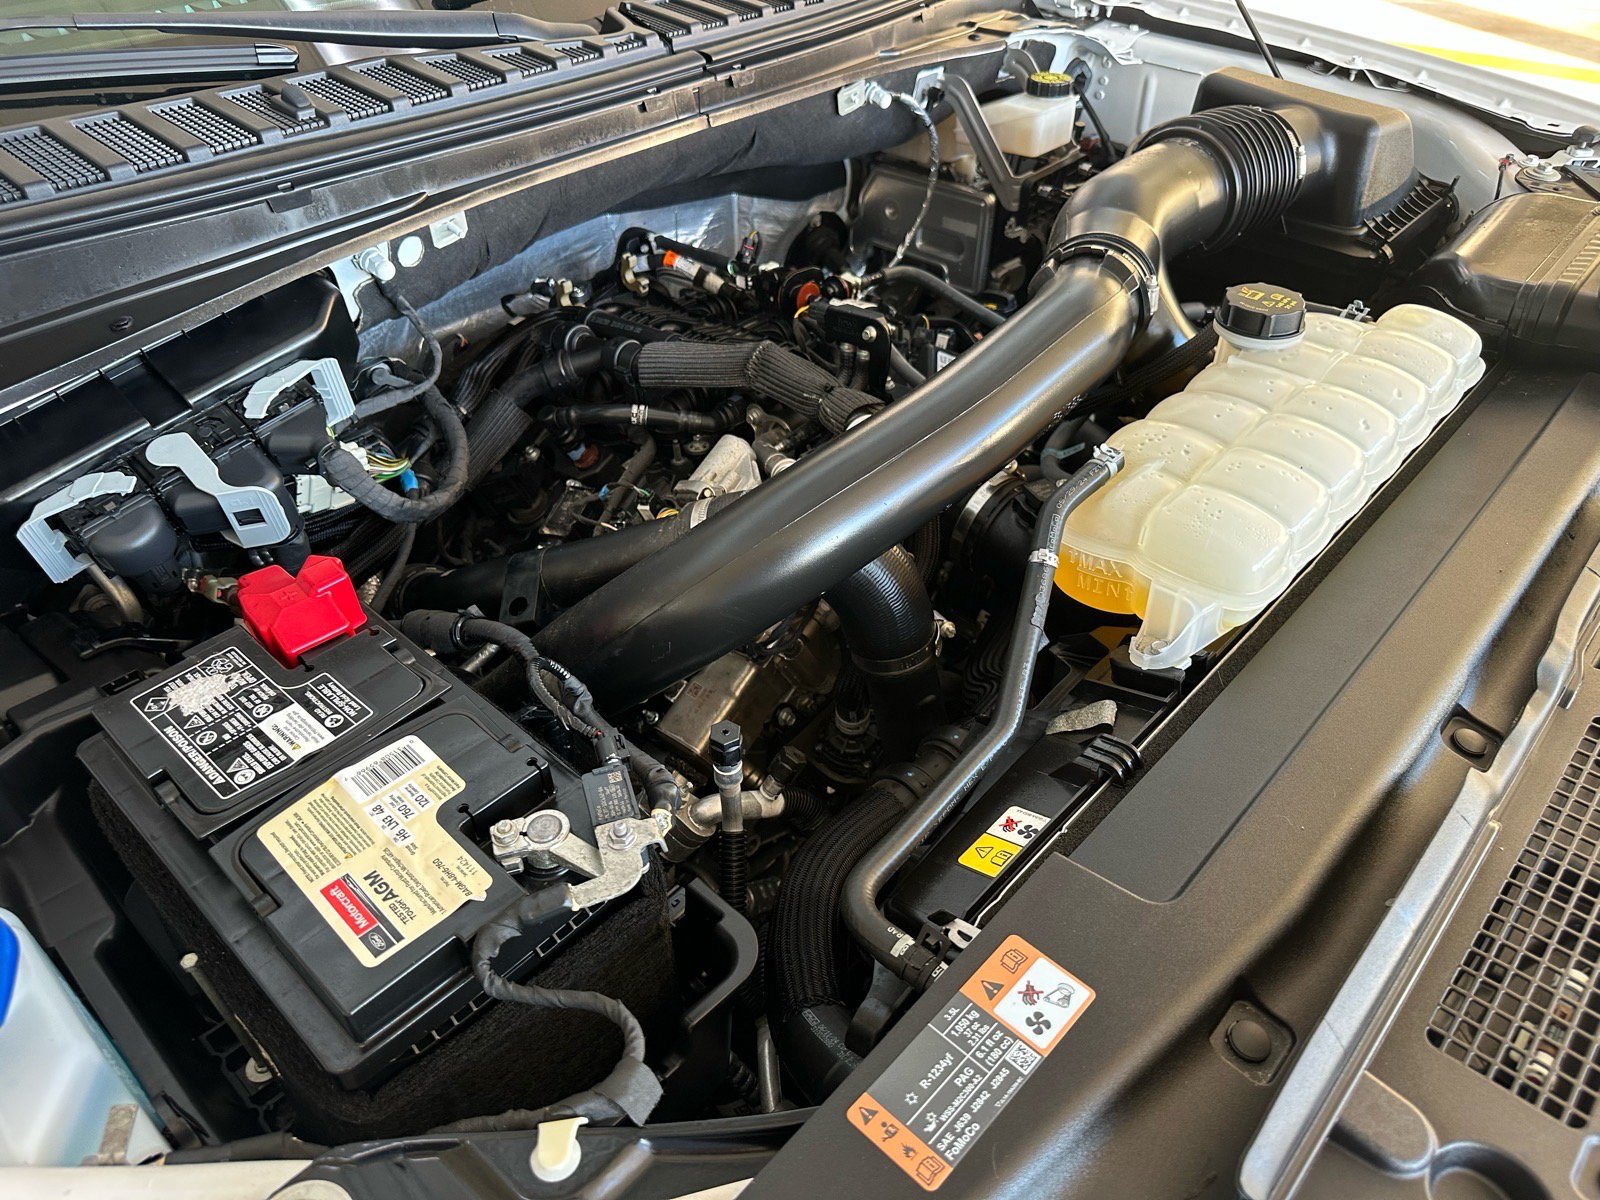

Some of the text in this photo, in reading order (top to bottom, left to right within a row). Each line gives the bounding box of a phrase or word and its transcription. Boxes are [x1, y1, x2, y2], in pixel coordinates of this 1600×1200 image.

[1079, 551, 1123, 578] MAX
[1077, 574, 1121, 598] MIN
[315, 683, 357, 716] NON-SPILLABLE
[270, 723, 296, 746] WARNING:
[163, 725, 220, 780] DANGER/POISON
[397, 803, 414, 819] 760
[413, 793, 430, 807] 120
[371, 803, 411, 841] H6 LN3 48
[456, 855, 478, 875] 111424
[362, 868, 399, 905] AGM
[327, 884, 370, 929] Motorcraft
[387, 901, 410, 925] TESTED
[943, 1004, 960, 1021] 3.5L
[949, 1007, 980, 1038] 1.050 kg
[962, 1020, 981, 1038] 37 oz
[966, 1022, 990, 1047] 2.31 lbs
[974, 1029, 1004, 1059] 6.1 fl oz
[984, 1034, 1014, 1067] (180 cc)
[918, 1051, 956, 1091] R-1234yf
[953, 1064, 975, 1088] PAG
[935, 1130, 955, 1152] SAE
[951, 1111, 972, 1133] J639
[968, 1089, 991, 1113] J2842
[988, 1066, 1010, 1090] J2845
[943, 1119, 981, 1161] FoMoCo
